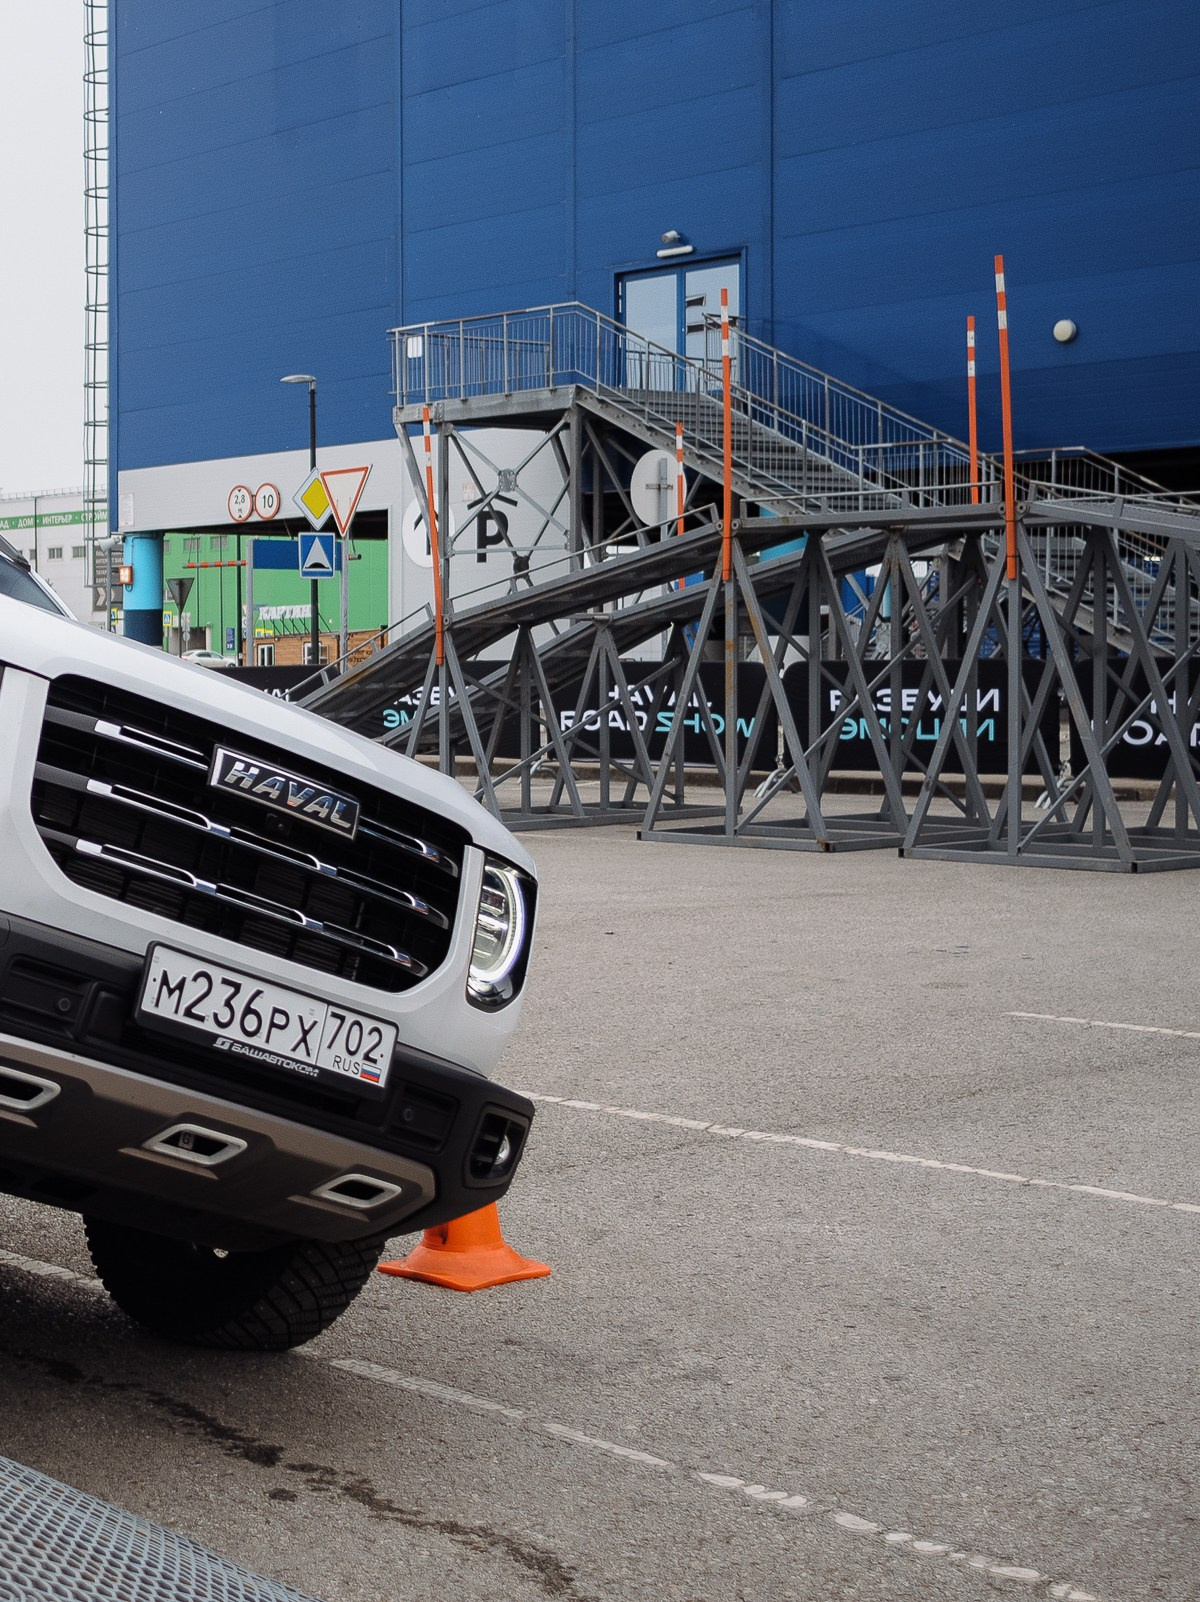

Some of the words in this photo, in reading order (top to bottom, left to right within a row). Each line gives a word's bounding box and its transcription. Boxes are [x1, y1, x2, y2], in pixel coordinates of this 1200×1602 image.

[262, 494, 274, 509] 10
[17, 518, 34, 529] ДОМ
[42, 513, 73, 525] ИНТЕРЬЕР
[224, 760, 352, 829] HAVAL
[326, 1010, 383, 1064] 702
[231, 1042, 320, 1077] БАШАВТОКОМ
[332, 1054, 360, 1076] RUS
